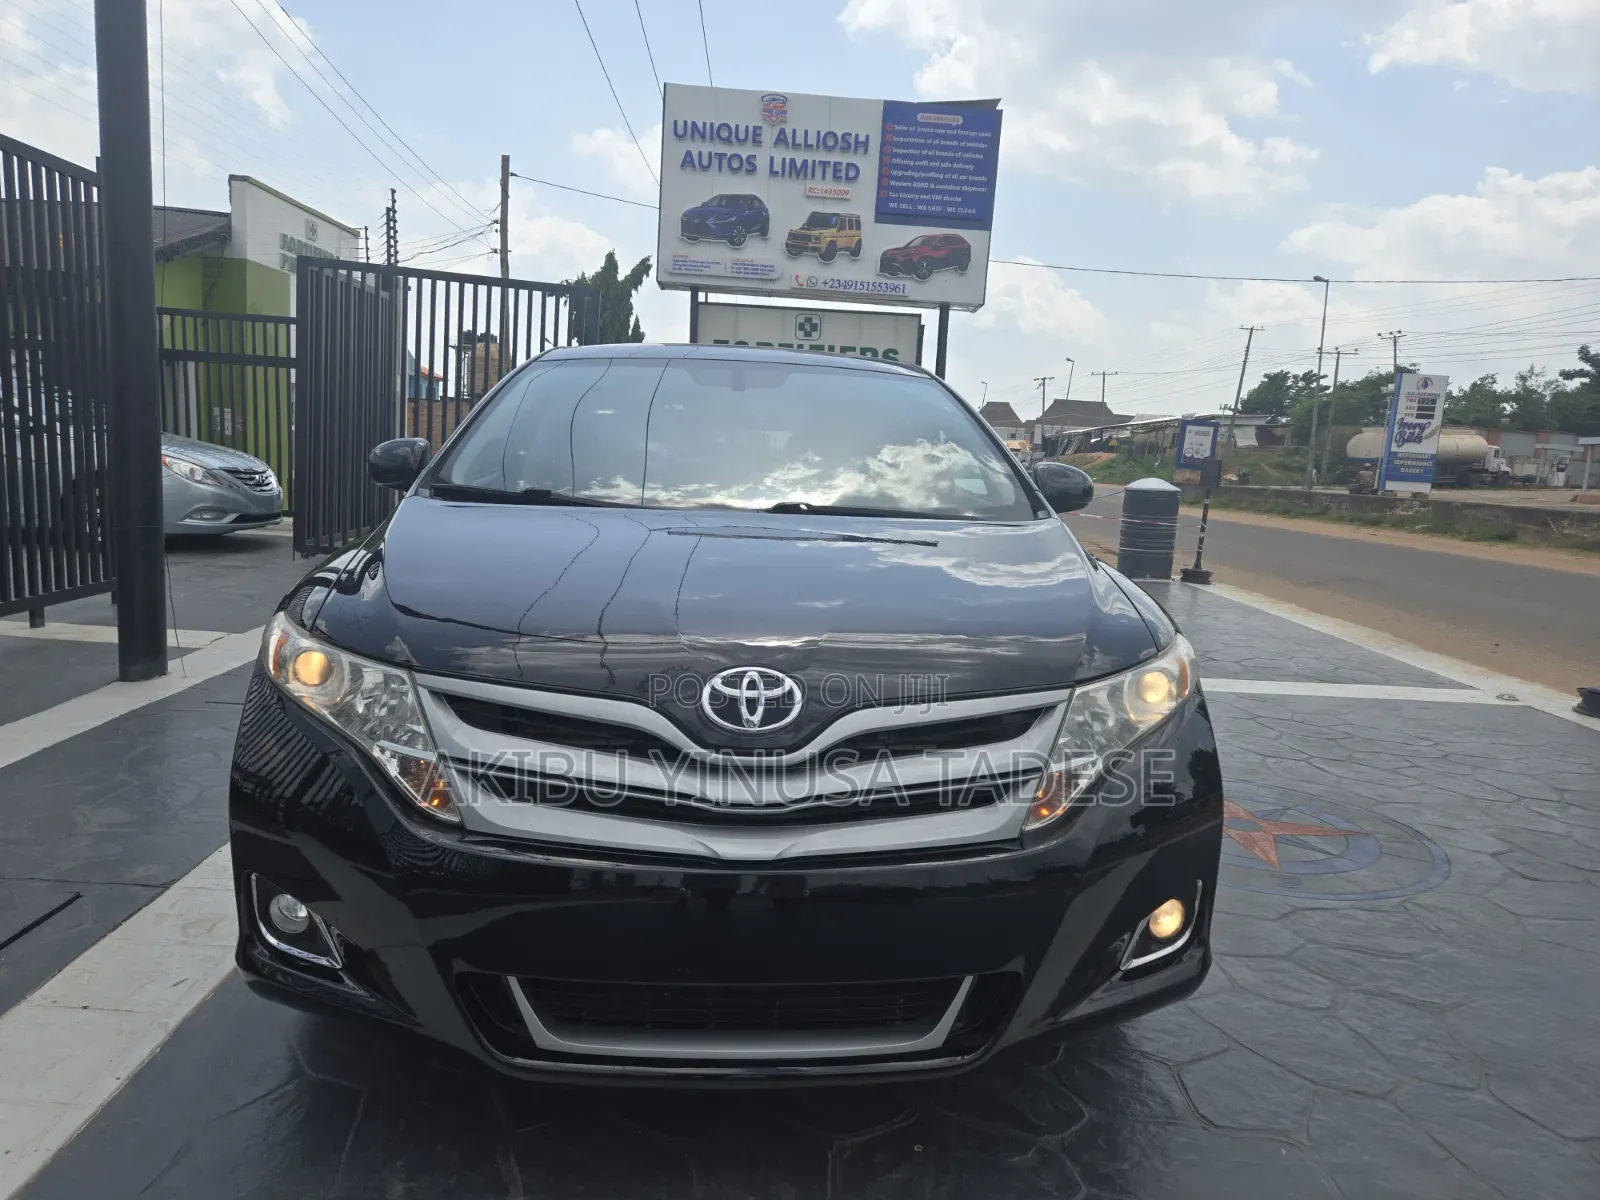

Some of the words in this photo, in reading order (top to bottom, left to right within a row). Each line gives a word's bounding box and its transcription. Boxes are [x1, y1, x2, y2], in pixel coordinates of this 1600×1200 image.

[673, 119, 763, 146] UNIQUE
[773, 127, 870, 155] ALLIOSH
[957, 129, 978, 137] foreign
[893, 136, 925, 144] Importation
[892, 147, 920, 155] Inspection
[962, 151, 984, 159] vehicles
[680, 149, 757, 173] AUTOS
[769, 155, 860, 181] LIMITED
[891, 158, 914, 166] Offering
[952, 162, 974, 170] delivery
[807, 186, 850, 197] RC:1435009
[935, 183, 961, 191] container
[962, 184, 987, 192] shipment
[899, 192, 919, 200] history
[821, 278, 906, 294] +2349151553961
[1397, 416, 1431, 435] Ivory
[1394, 430, 1424, 448] Bites
[1393, 459, 1433, 467] SUPERMARKET
